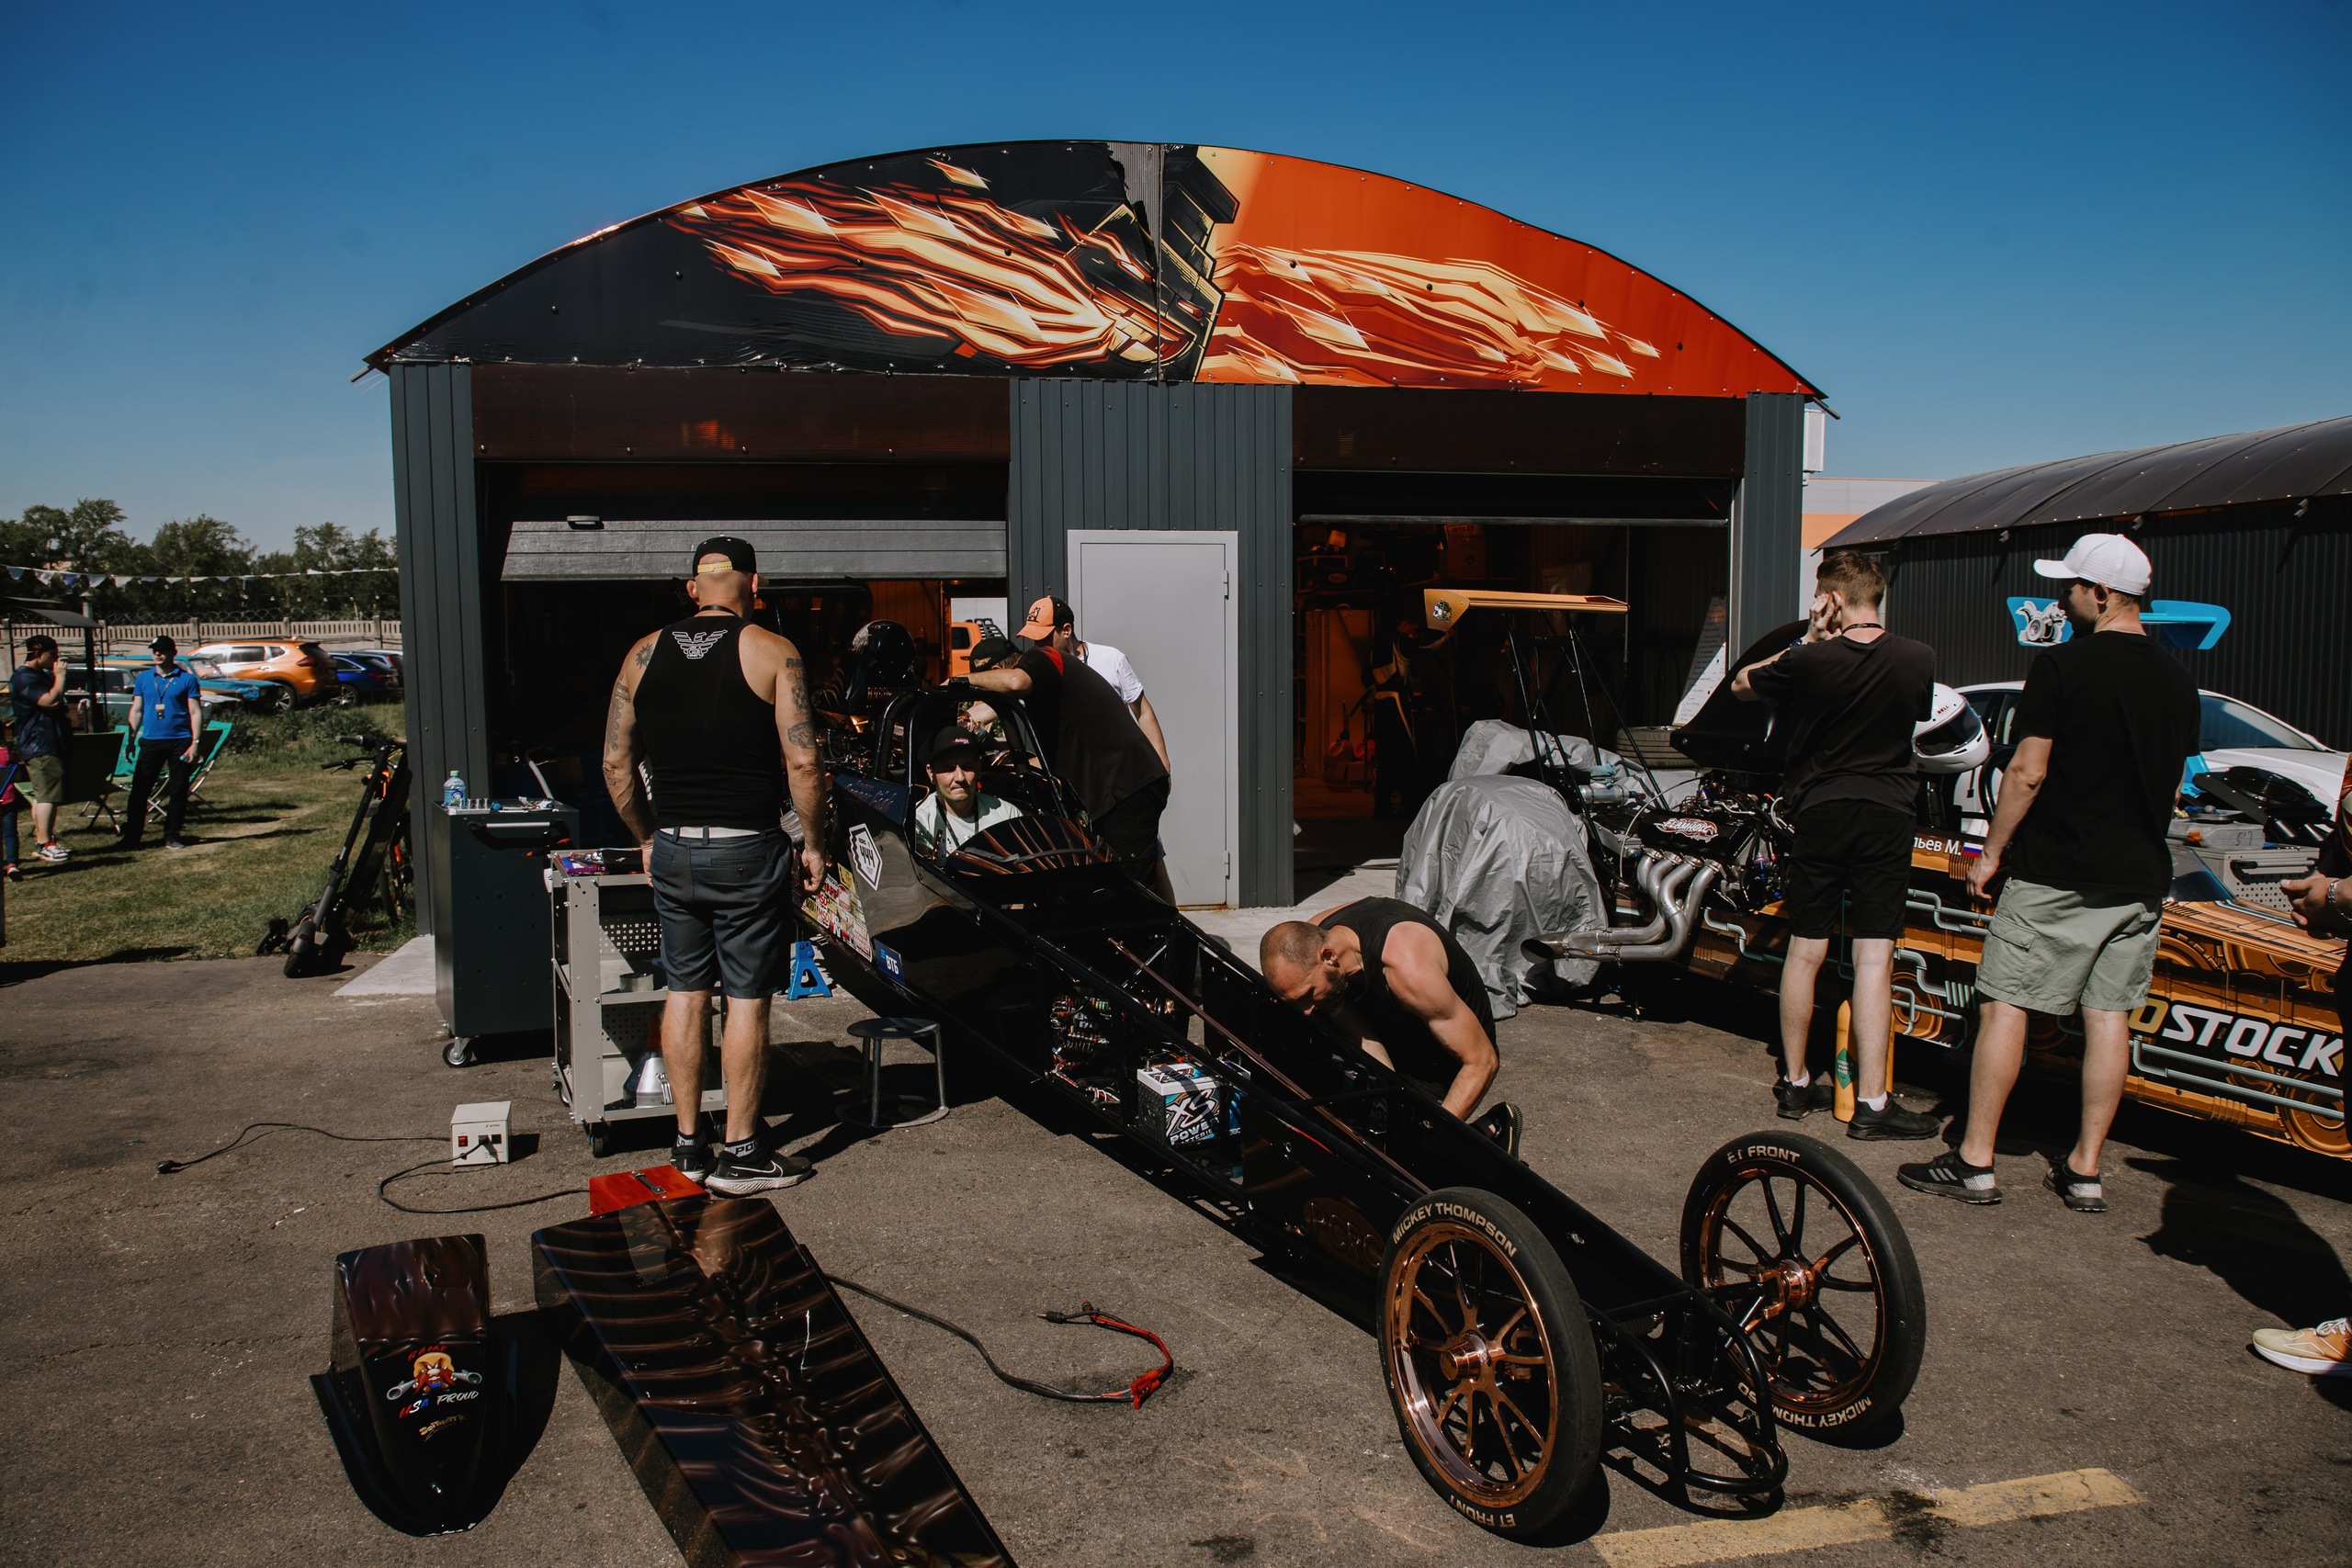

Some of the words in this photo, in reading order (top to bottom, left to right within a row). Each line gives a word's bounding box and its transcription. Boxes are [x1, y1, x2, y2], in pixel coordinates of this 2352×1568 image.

[1937, 705, 1949, 715] BELL
[735, 1140, 756, 1155] PO
[1747, 1145, 1801, 1164] FRONT
[1392, 1203, 1432, 1245] MICKEY
[1434, 1202, 1518, 1258] THOMPSON
[399, 1398, 429, 1418] USA
[436, 1391, 479, 1405] PROUD
[1818, 1396, 1872, 1427] MICKEY
[1449, 1495, 1496, 1528] FRONT
[1499, 1513, 1517, 1528] ET
